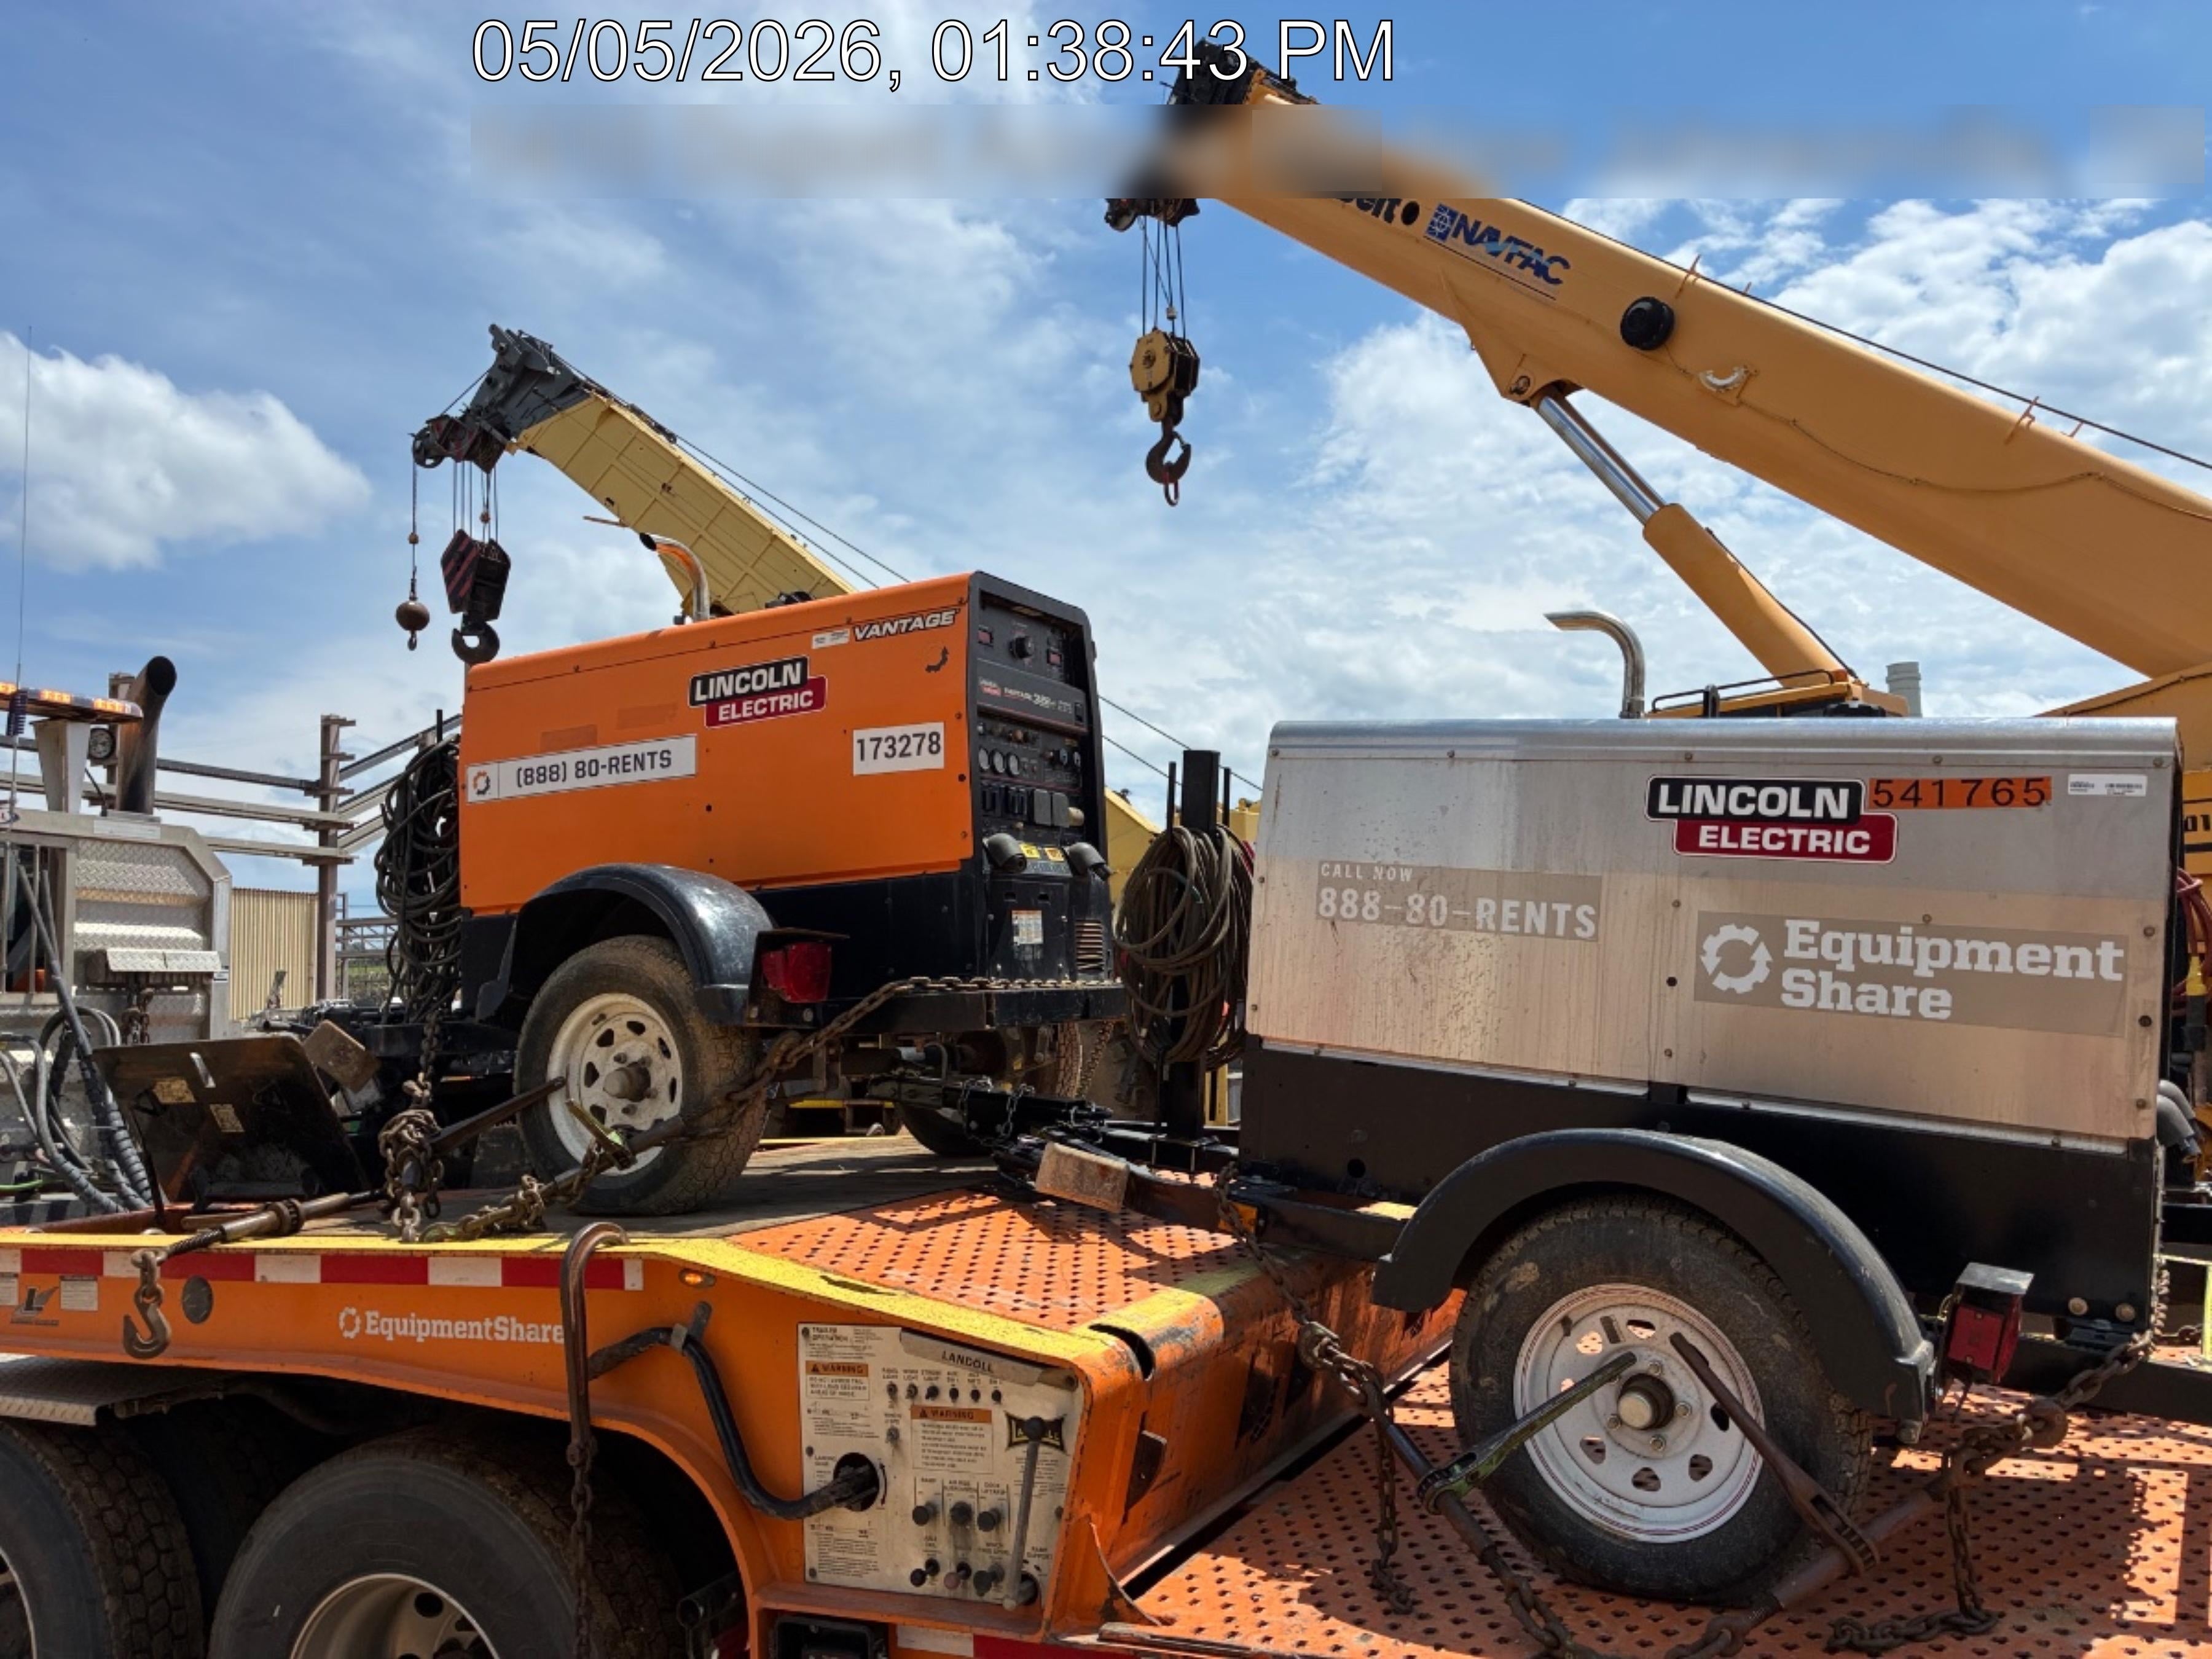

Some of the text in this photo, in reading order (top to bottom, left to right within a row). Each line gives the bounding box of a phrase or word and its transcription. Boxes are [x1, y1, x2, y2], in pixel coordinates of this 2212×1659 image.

[1451, 213, 1571, 286] NAVFAC
[853, 609, 959, 641] VANTAGE
[694, 662, 801, 702] LINCOLN
[718, 690, 814, 722] ELECTRIC
[857, 731, 941, 761] 173278
[516, 749, 672, 788] (888) 80-RENTS
[1658, 783, 1849, 819] LINCOLN
[1872, 777, 2046, 807] 541765
[1698, 825, 1870, 854] ELECTRIC
[1321, 862, 1413, 882] CALL NOW
[1319, 887, 1596, 939] 888-80-RENTS
[1783, 919, 2125, 982] Equipment
[1781, 967, 1953, 1021] Share
[364, 1310, 565, 1343] EquipmentShare
[822, 1363, 863, 1374] WARNING
[941, 1351, 994, 1374] LANDOLL
[930, 1409, 975, 1420] WARNING
